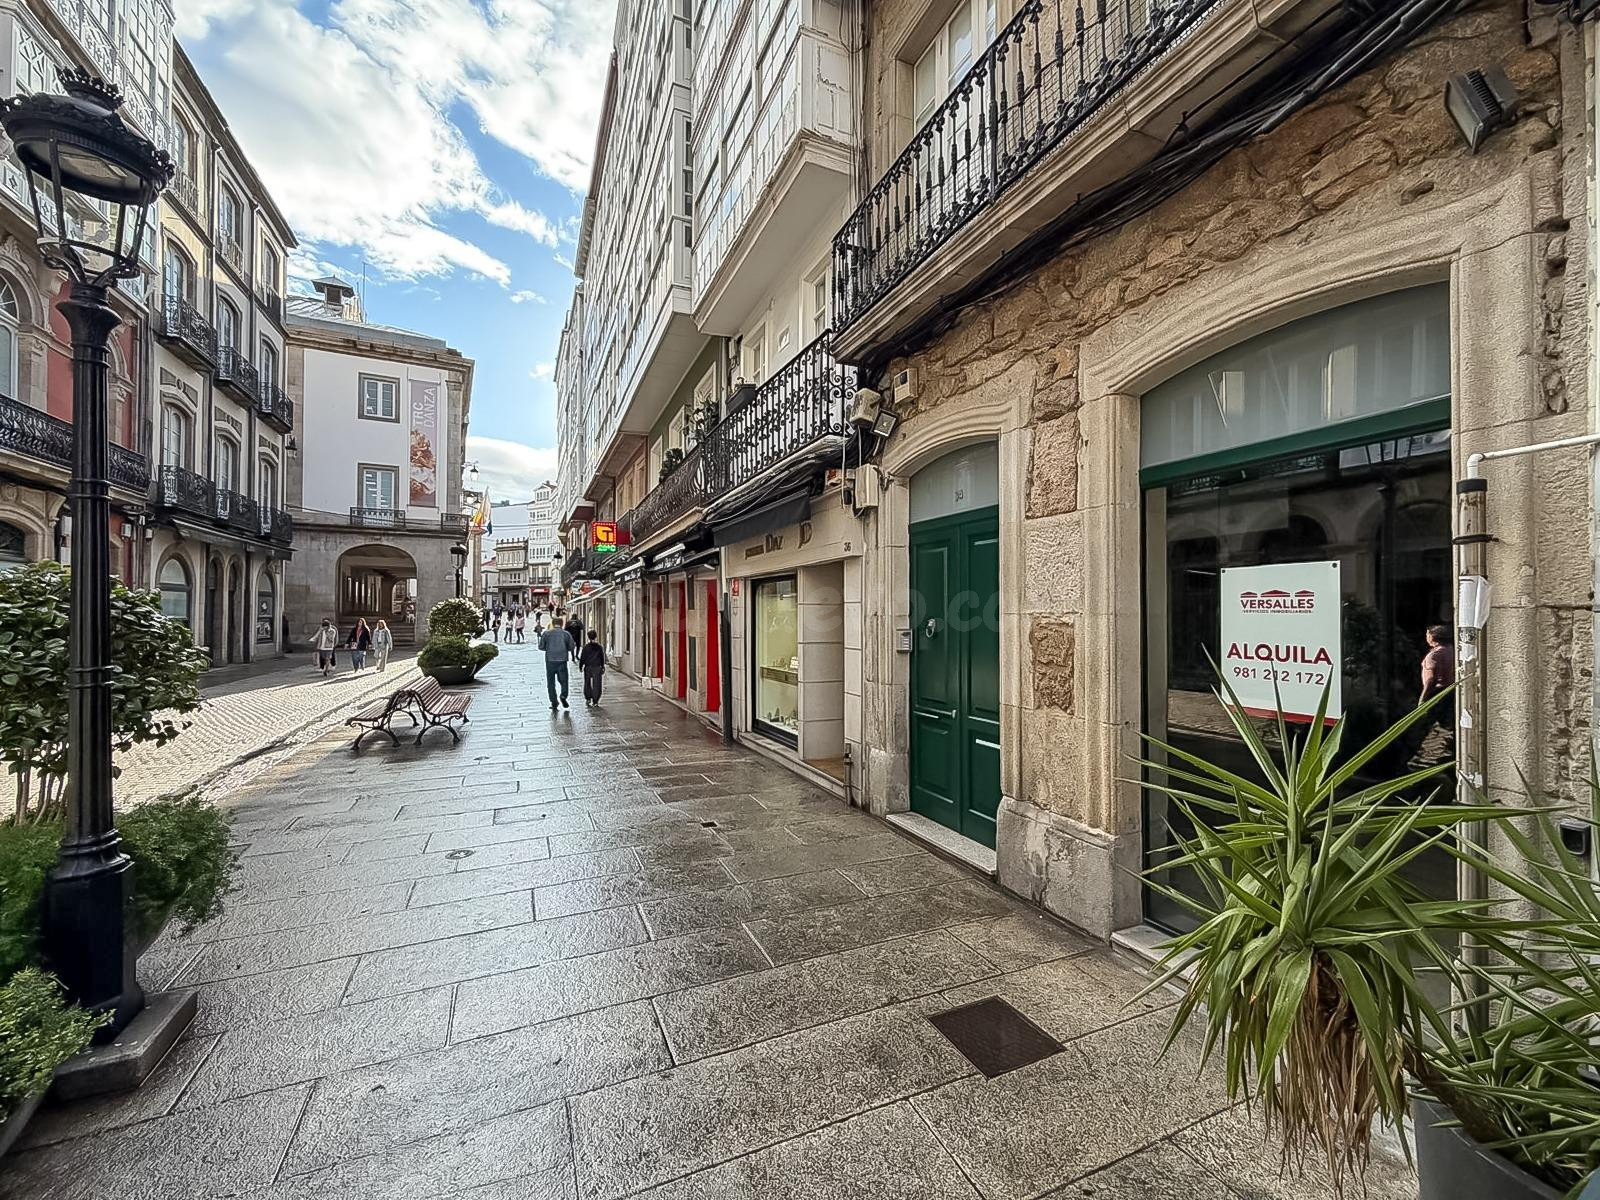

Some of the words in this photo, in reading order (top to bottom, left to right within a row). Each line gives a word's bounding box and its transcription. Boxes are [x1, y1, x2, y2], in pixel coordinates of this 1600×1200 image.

[424, 387, 436, 429] DANZA
[844, 542, 852, 552] 36
[1240, 599, 1315, 609] VERSALLES
[1227, 643, 1332, 666] ALQUILA
[1233, 667, 1256, 679] 981
[1263, 669, 1290, 682] 212
[1296, 672, 1325, 685] 172
